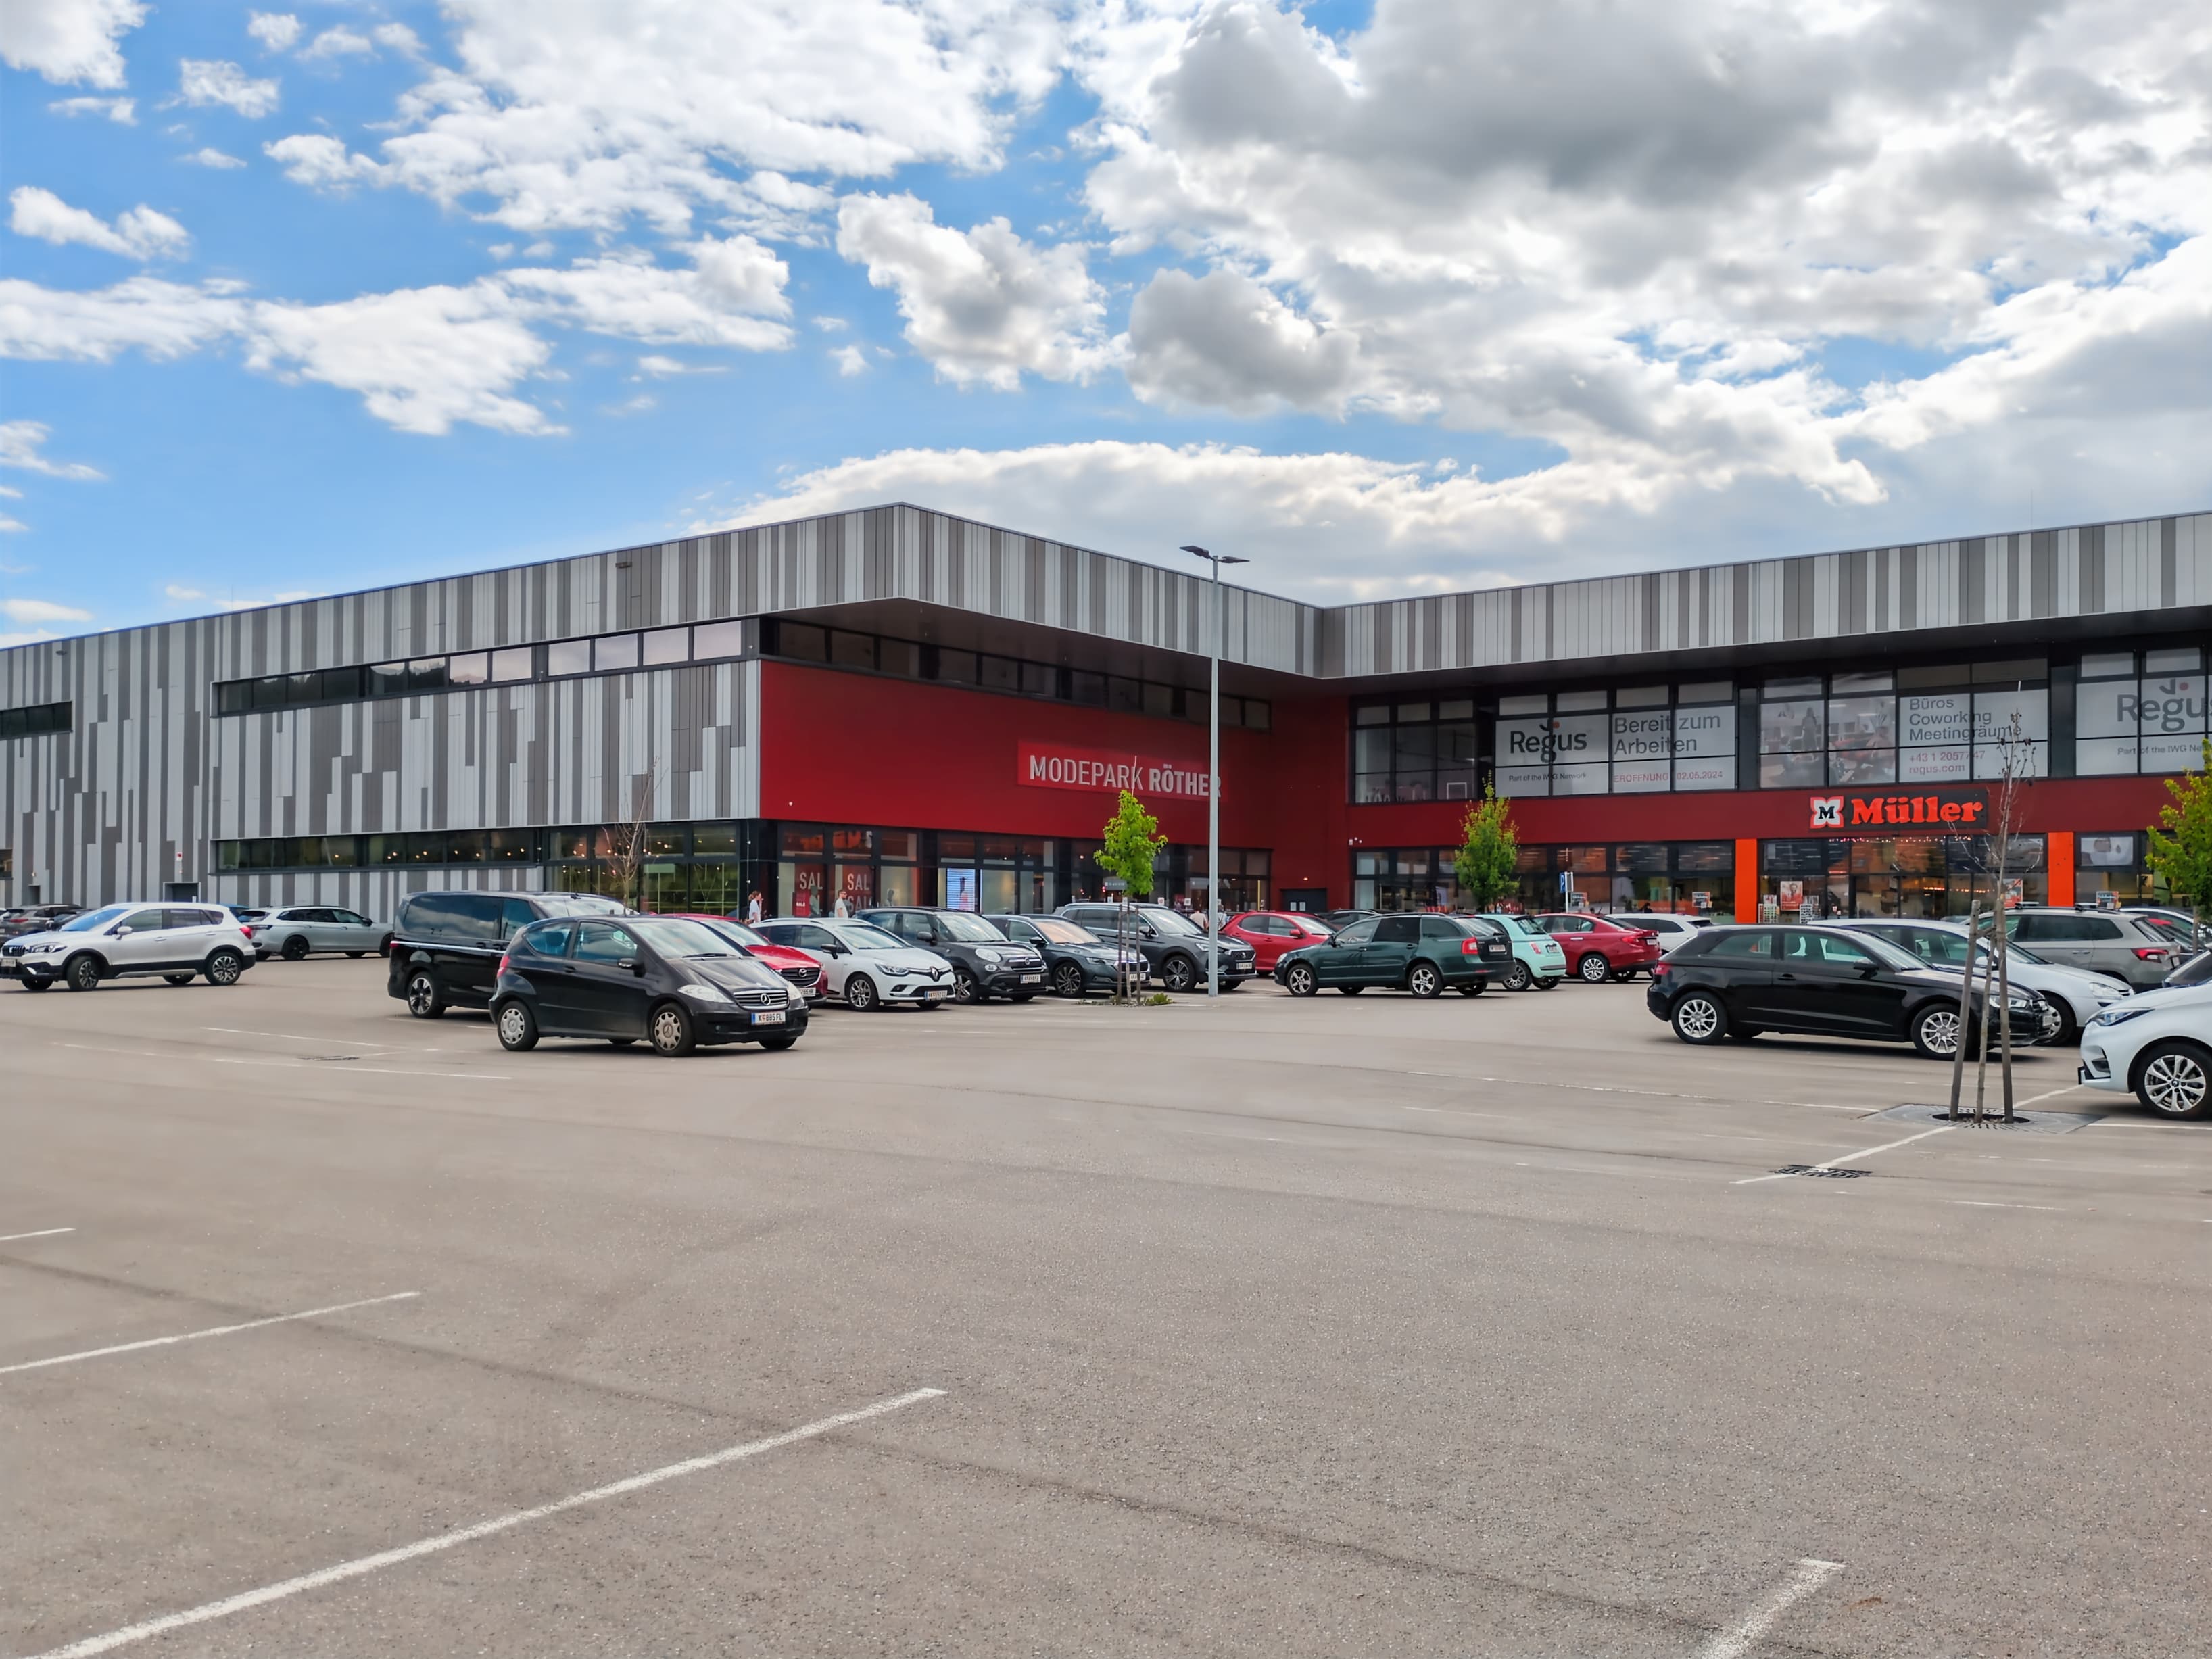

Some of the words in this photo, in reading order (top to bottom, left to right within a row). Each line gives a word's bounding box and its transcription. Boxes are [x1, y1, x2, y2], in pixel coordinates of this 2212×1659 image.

[1910, 698, 1954, 710] Büros
[2117, 694, 2212, 732] Regu
[1614, 715, 1671, 734] Bereit
[1679, 715, 1721, 730] zum
[1909, 711, 1992, 725] Coworkng
[1510, 729, 1587, 763] Regus
[1614, 737, 1697, 755] Arbeiten
[1030, 755, 1143, 790] MODEPARK
[1819, 806, 1835, 819] M
[1851, 796, 1983, 825] Müller
